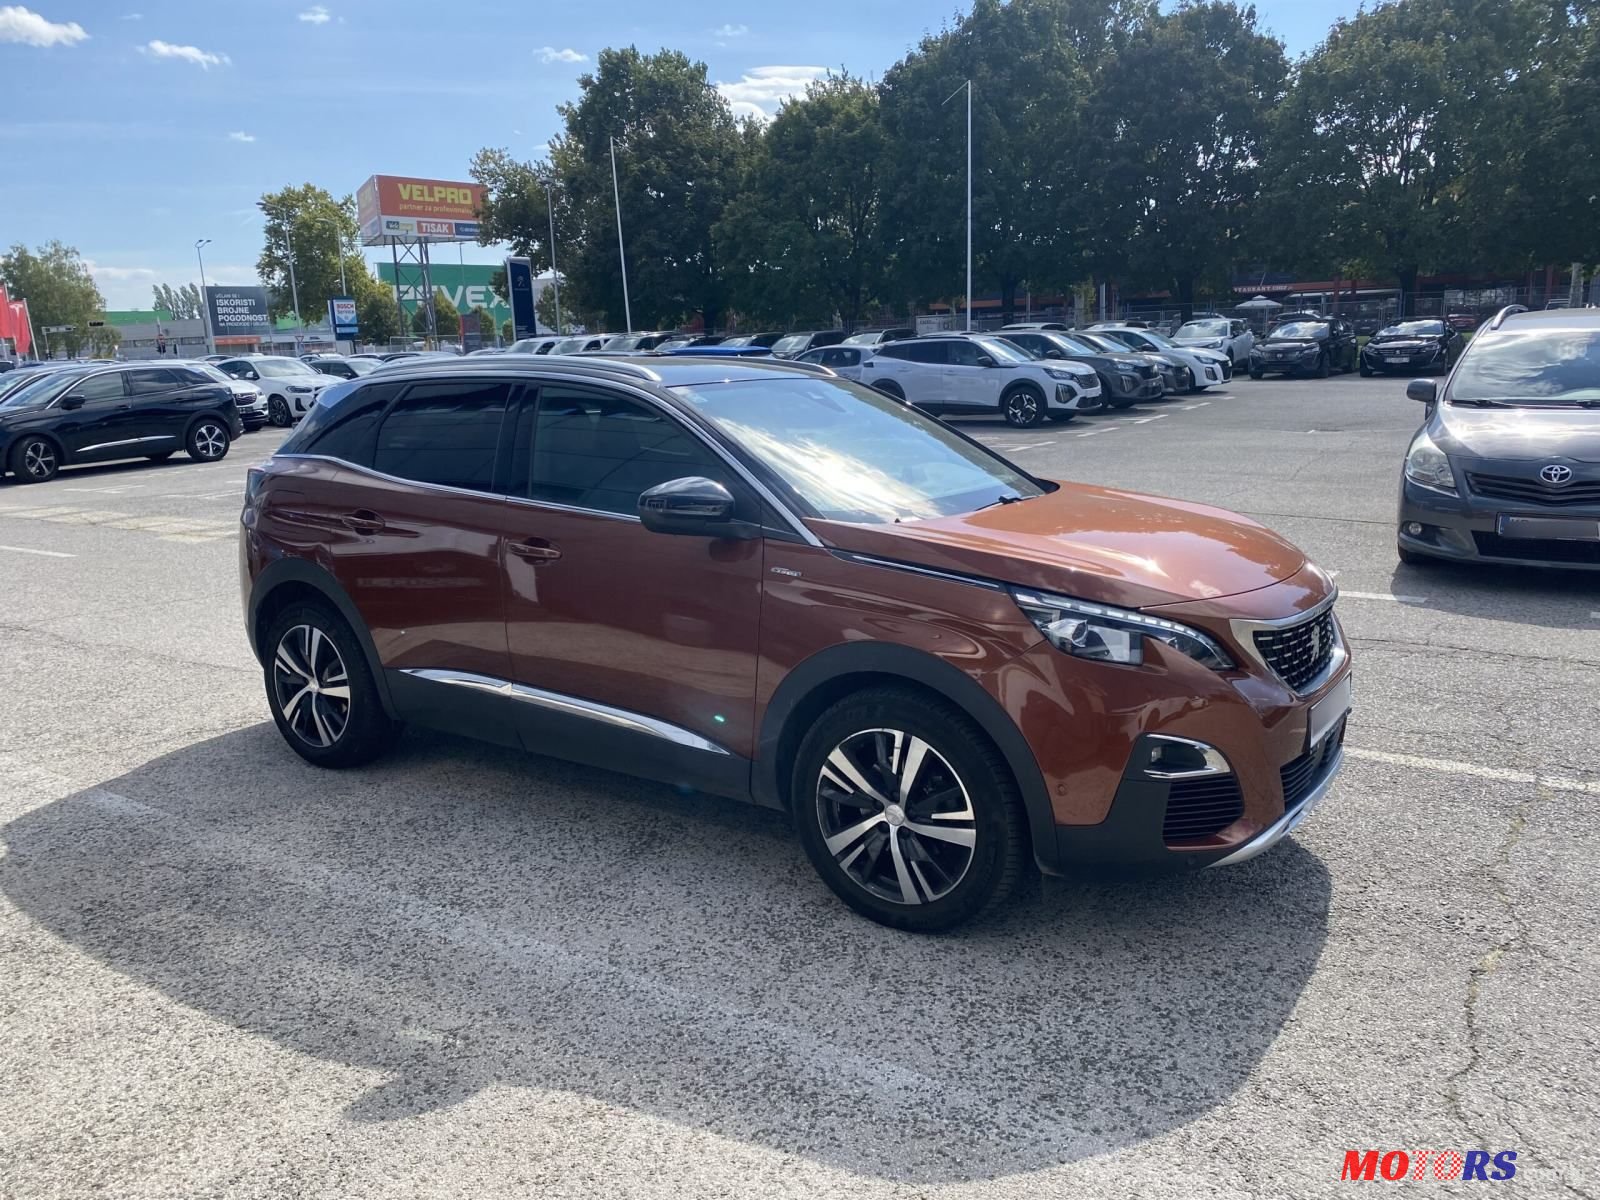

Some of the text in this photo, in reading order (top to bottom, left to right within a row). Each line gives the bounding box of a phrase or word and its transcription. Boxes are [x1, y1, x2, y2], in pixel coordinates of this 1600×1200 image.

[398, 184, 472, 204] VELPRO
[400, 204, 422, 212] partner
[421, 222, 449, 233] TISAK
[216, 298, 256, 306] ISKORISTI
[217, 306, 250, 314] BROJNE
